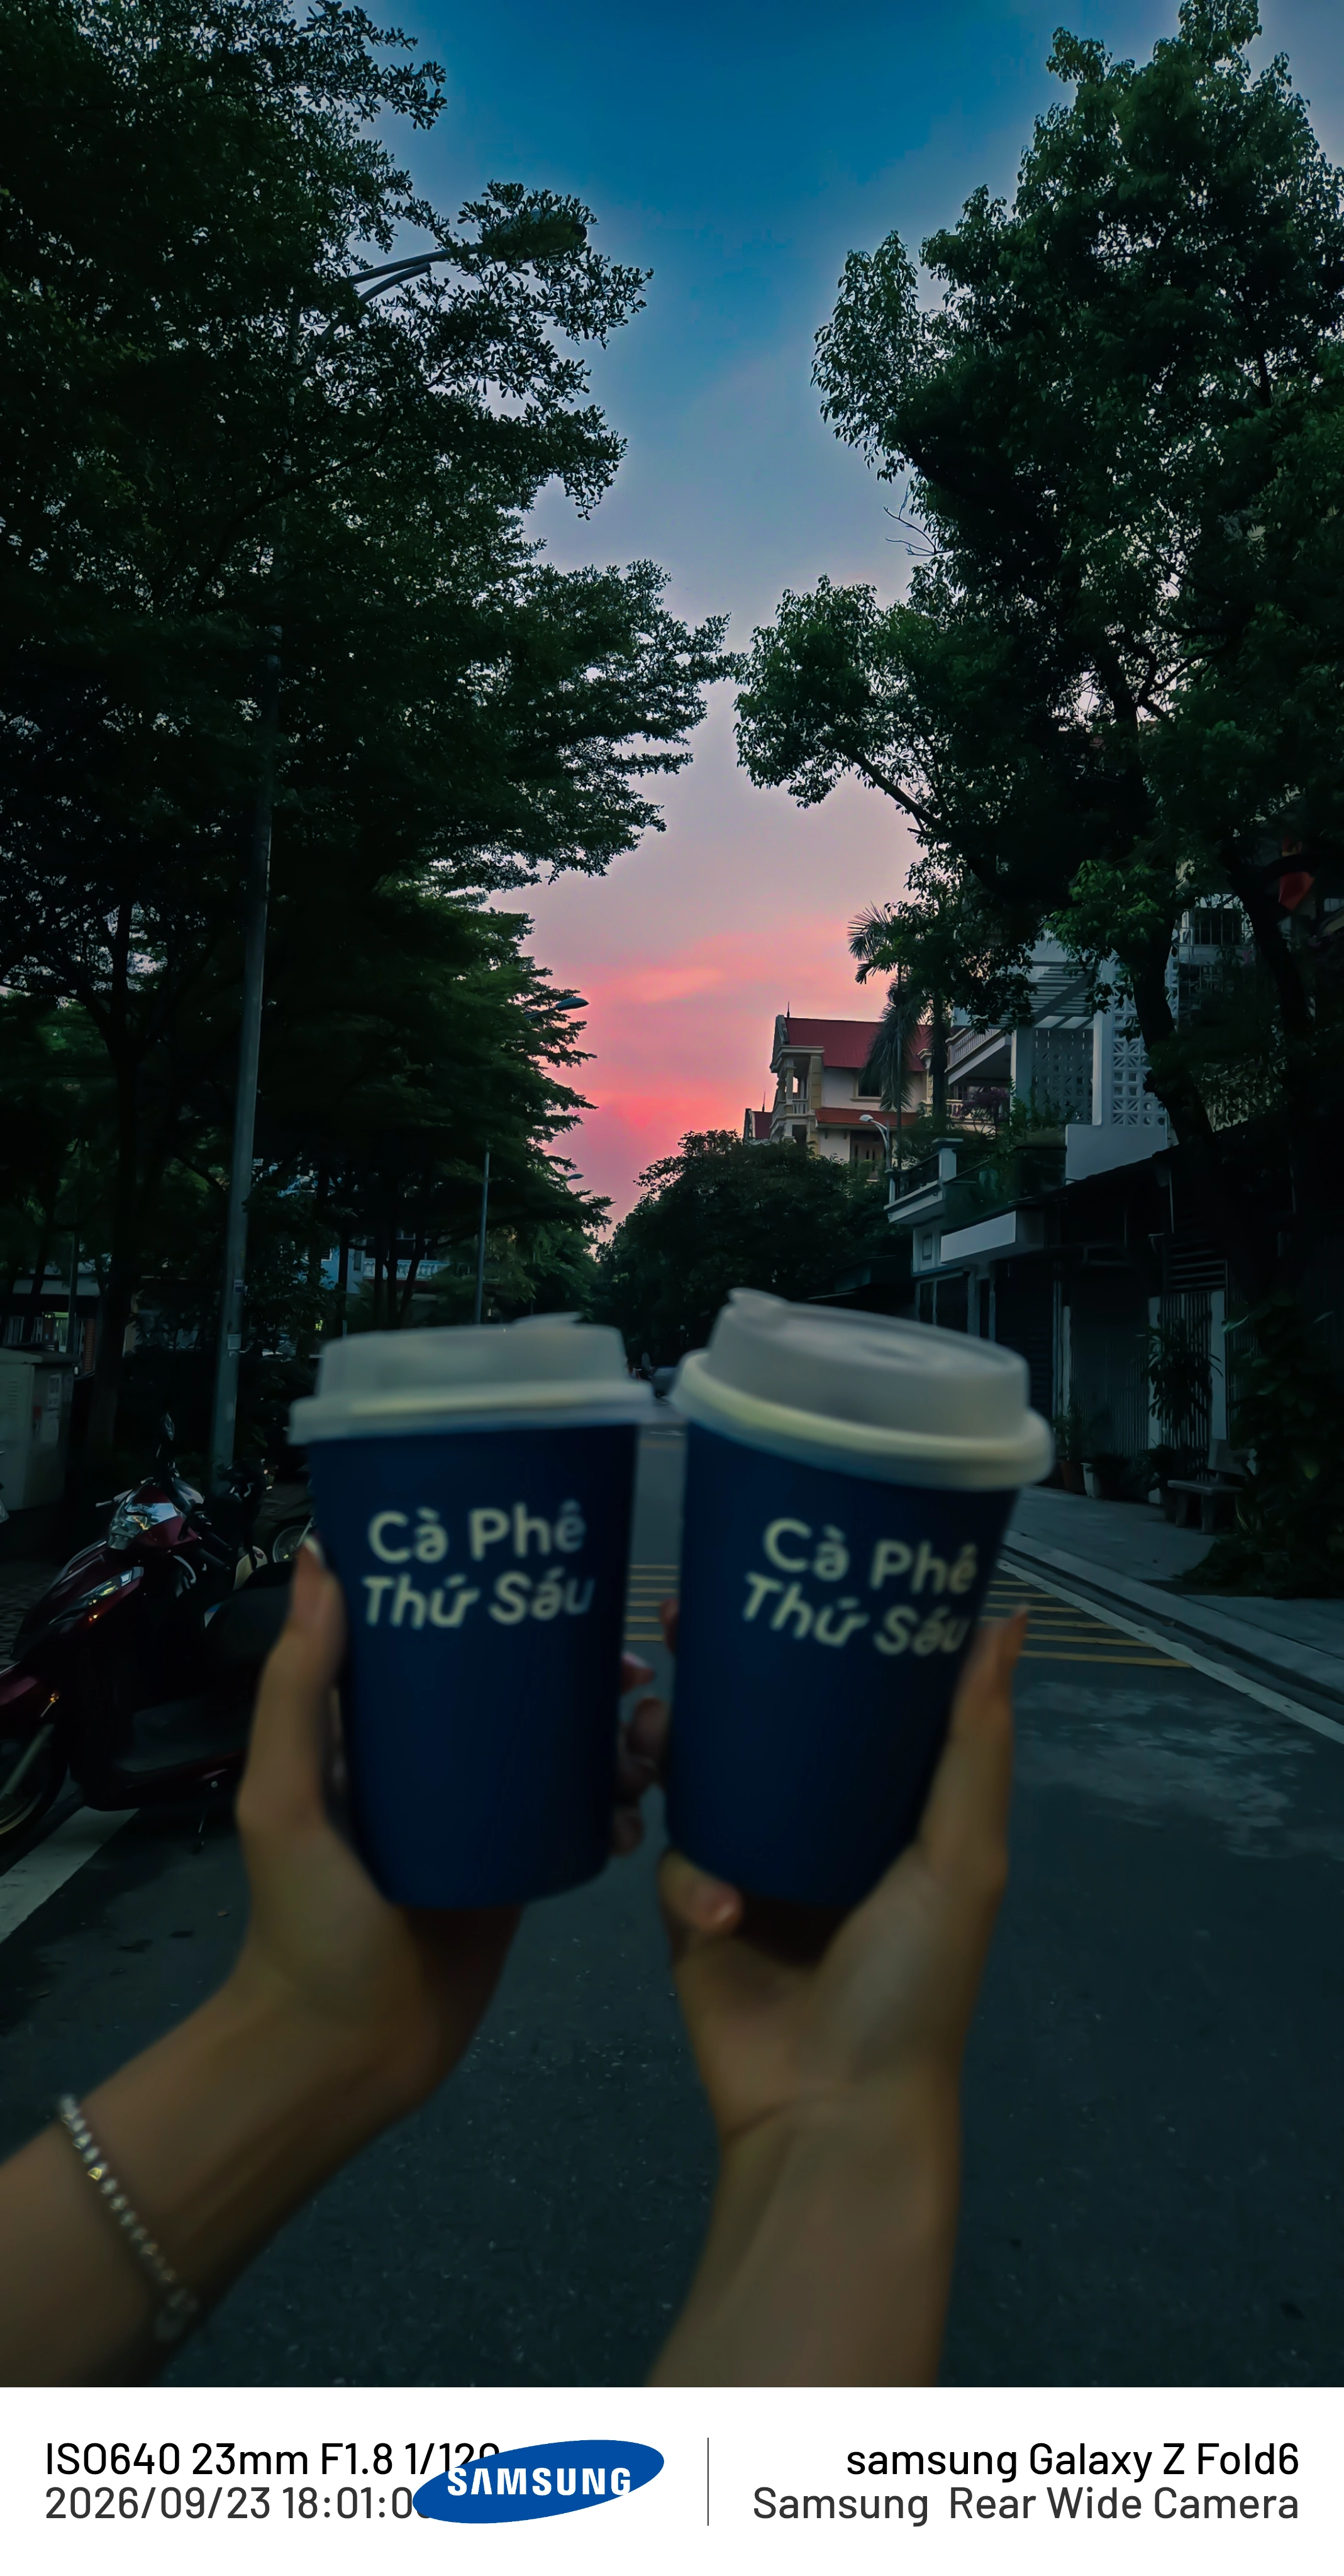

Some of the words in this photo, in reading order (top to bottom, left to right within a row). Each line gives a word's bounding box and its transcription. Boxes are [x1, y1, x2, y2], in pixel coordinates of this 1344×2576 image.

[369, 1506, 449, 1564] Cà
[469, 1498, 586, 1562] Phê
[763, 1517, 849, 1582] Cà
[869, 1538, 977, 1594] Phê
[361, 1572, 480, 1630] Thứ
[488, 1567, 595, 1625] Sáu
[742, 1571, 870, 1648] Thứ
[874, 1604, 971, 1656] Sáu
